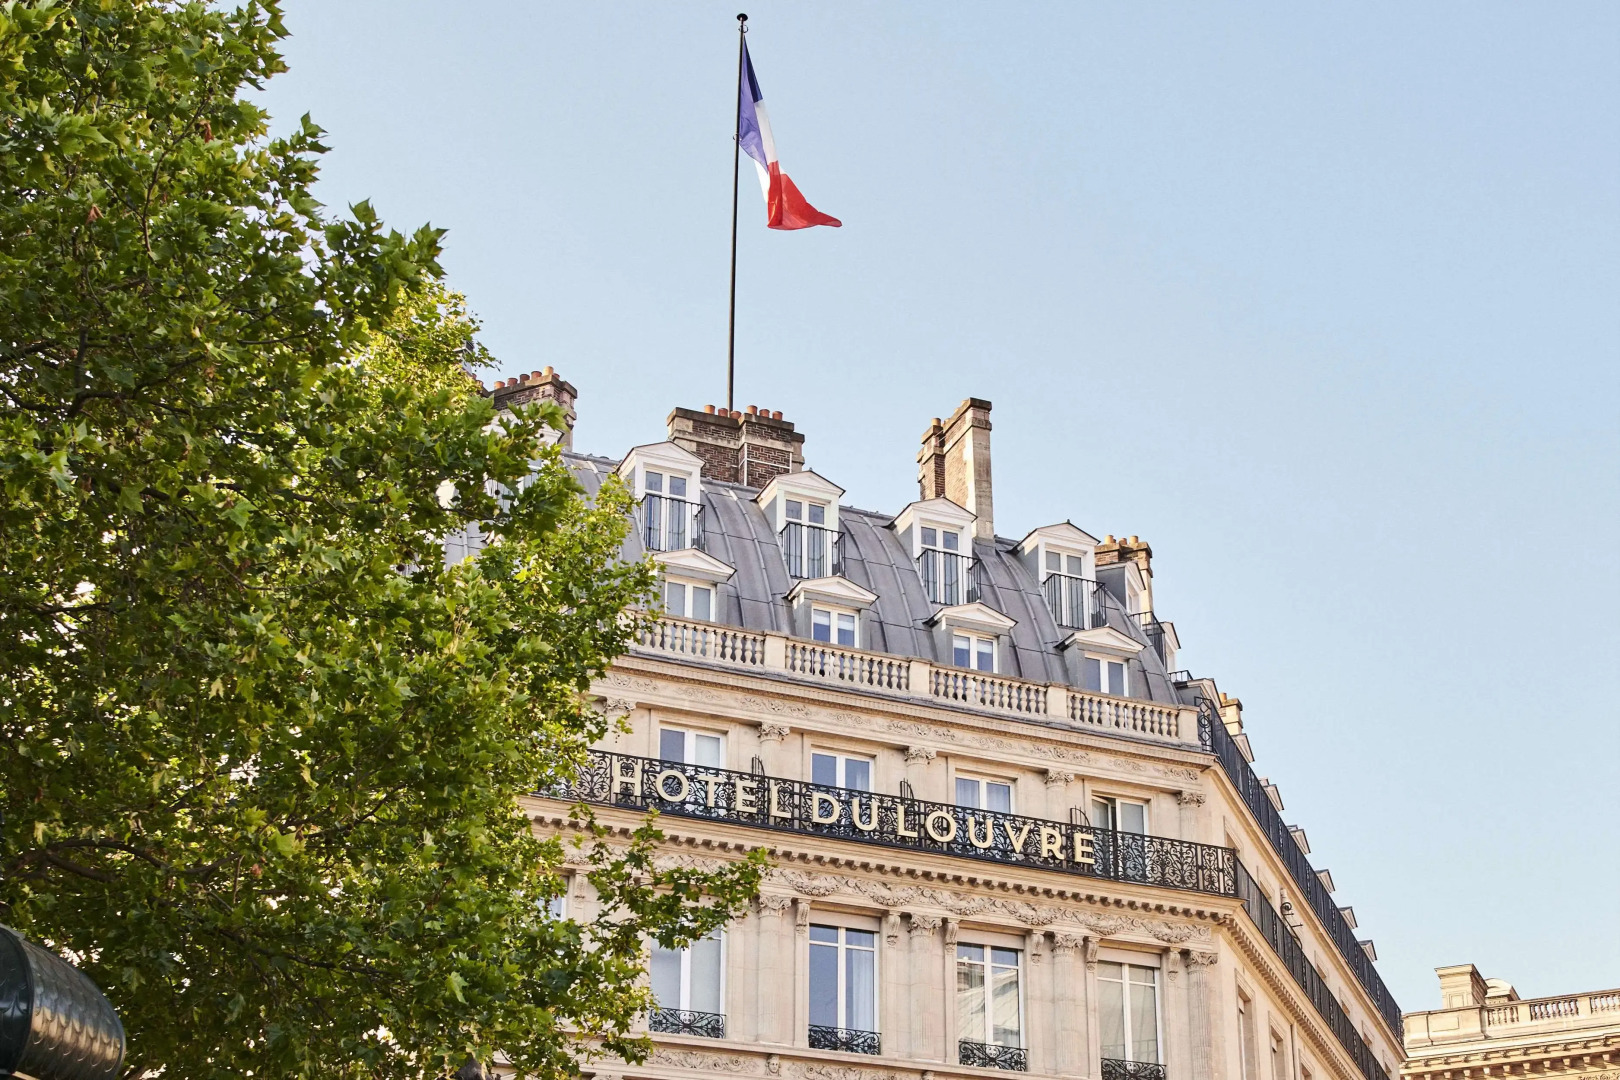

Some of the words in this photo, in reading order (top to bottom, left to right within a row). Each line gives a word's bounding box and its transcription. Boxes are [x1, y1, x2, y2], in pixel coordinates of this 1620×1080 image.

[613, 756, 792, 818] HOTEL
[811, 792, 879, 831] DU
[897, 804, 1096, 864] LOUVRE
